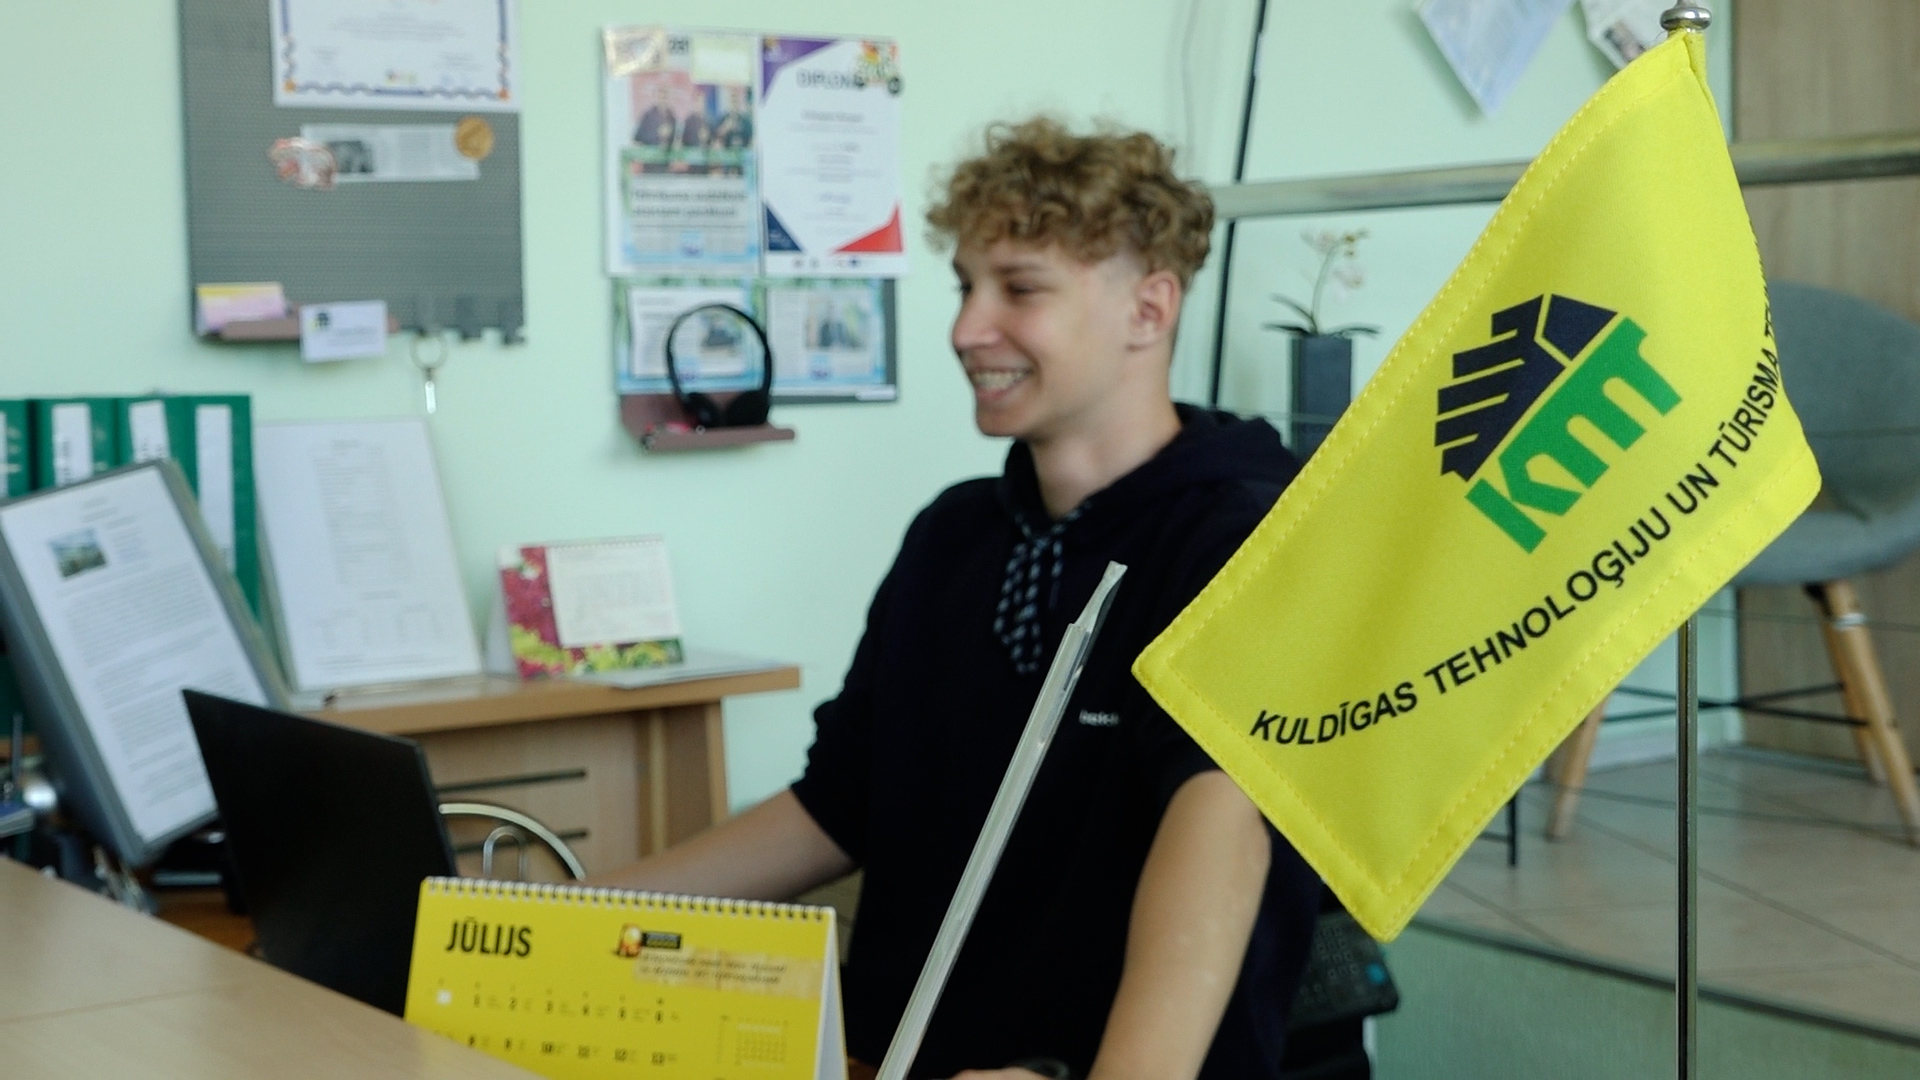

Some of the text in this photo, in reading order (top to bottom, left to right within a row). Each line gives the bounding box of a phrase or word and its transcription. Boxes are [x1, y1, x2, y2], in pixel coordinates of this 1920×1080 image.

[1249, 347, 1780, 745] KULDĪGAS TEHNOLOĢIJU UN TŪRISMA
[446, 916, 531, 957] JŪLIJS
